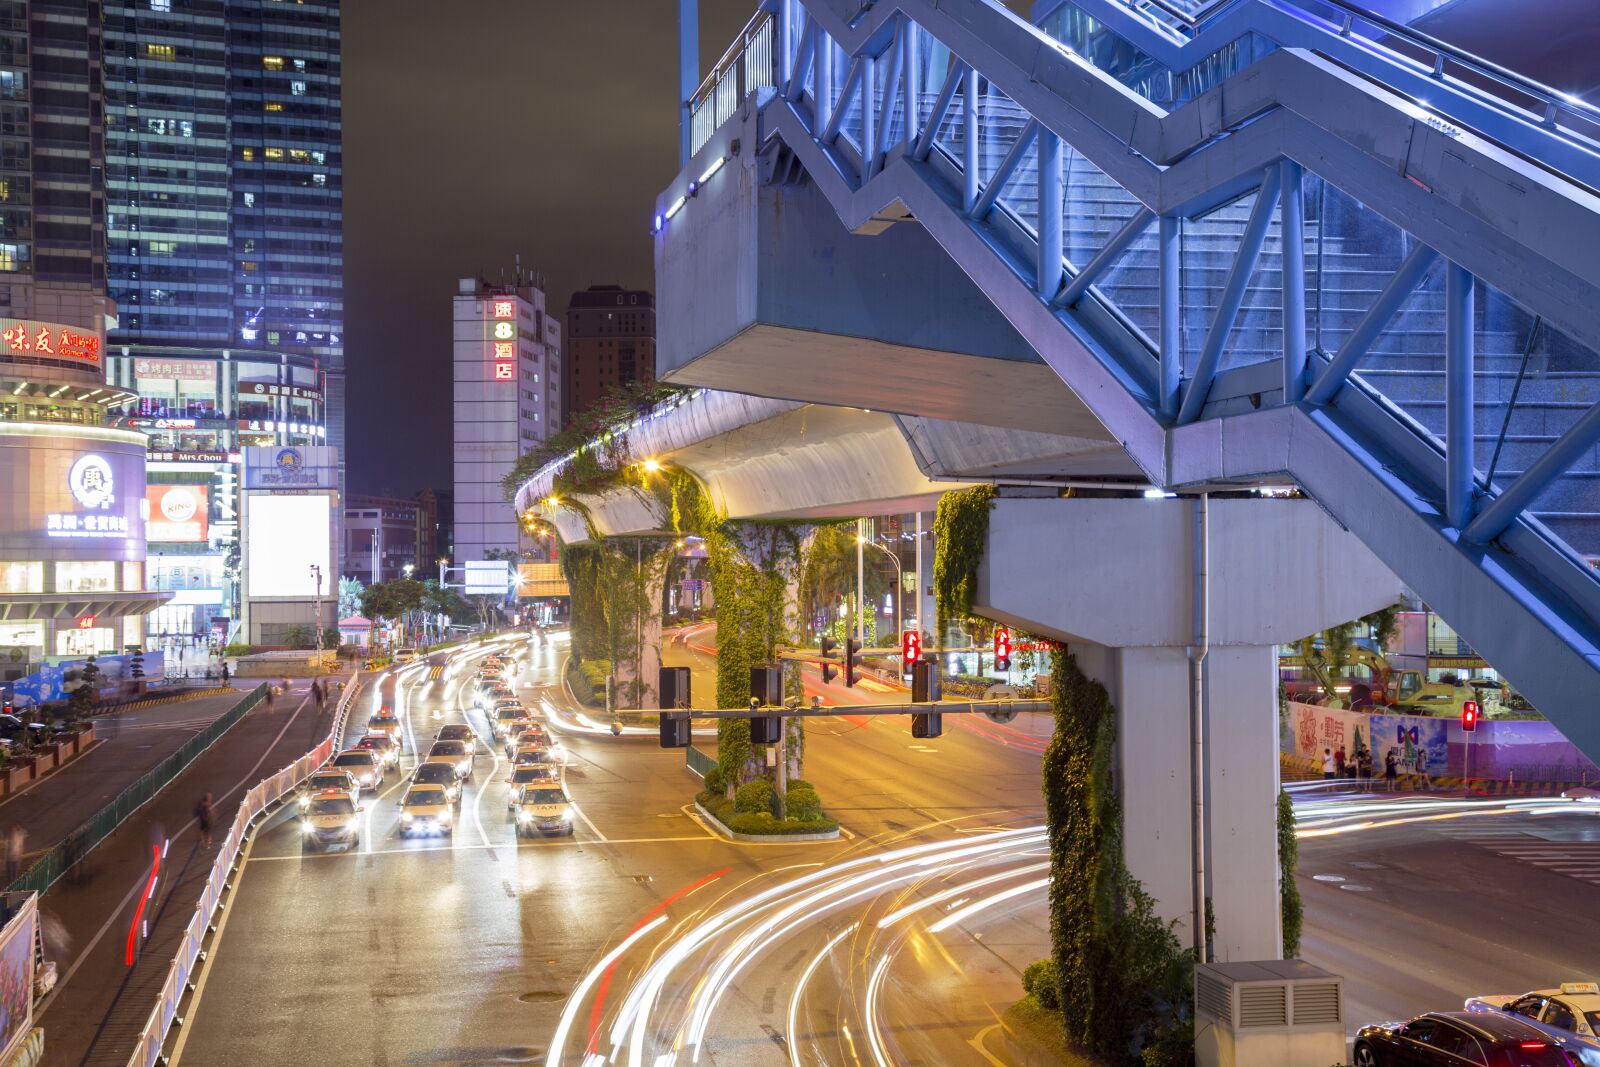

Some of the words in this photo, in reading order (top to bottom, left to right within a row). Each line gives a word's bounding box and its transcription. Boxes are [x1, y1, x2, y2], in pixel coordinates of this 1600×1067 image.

[495, 302, 513, 378] 速8酒店
[179, 453, 221, 461] Mrs.Chou
